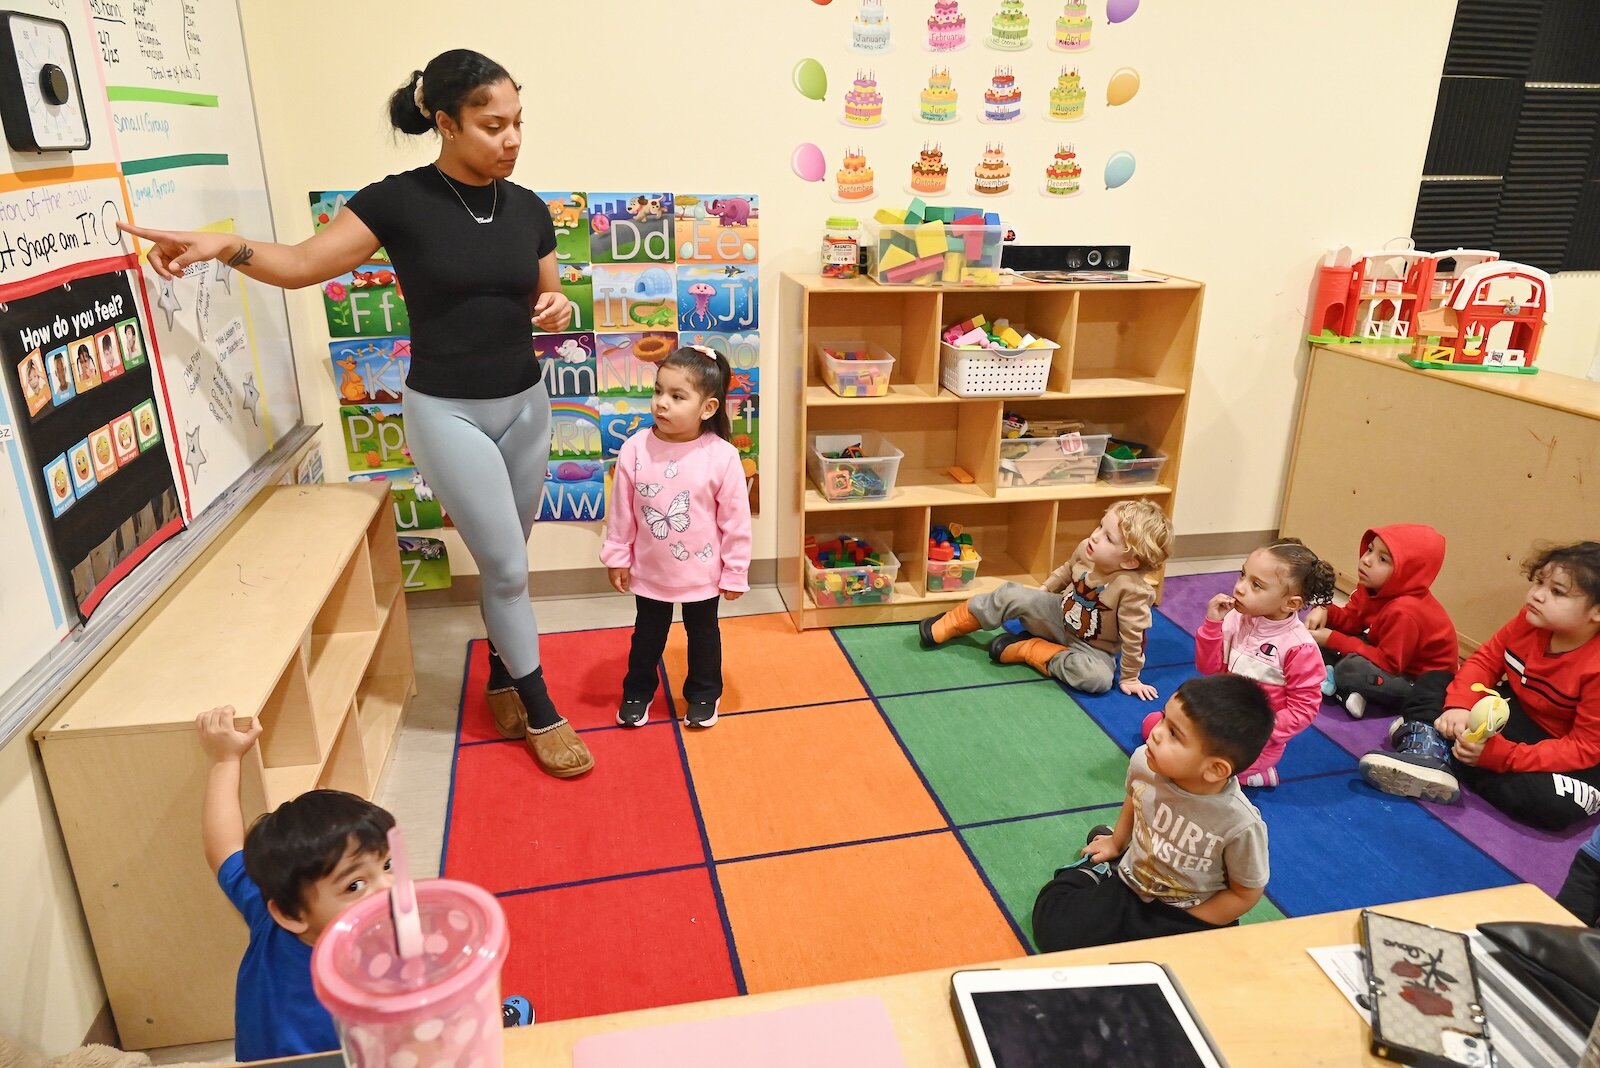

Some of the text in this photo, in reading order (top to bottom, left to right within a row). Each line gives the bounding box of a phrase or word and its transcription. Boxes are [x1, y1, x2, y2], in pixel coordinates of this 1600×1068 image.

[856, 33, 887, 45] January
[931, 33, 963, 41] February
[998, 31, 1021, 40] March
[1065, 33, 1082, 42] April
[929, 105, 947, 114] June
[994, 105, 1010, 114] July
[1055, 104, 1079, 112] August
[114, 112, 169, 139] Small Group
[838, 185, 874, 193] September
[914, 177, 941, 187] October
[975, 178, 1009, 187] November
[1047, 179, 1080, 187] December
[26, 192, 40, 219] of
[42, 187, 61, 214] the
[59, 232, 80, 251] am
[611, 219, 669, 260] Dd
[693, 219, 742, 260] Ee
[718, 276, 754, 326] Jj
[349, 290, 395, 334] Ff
[20, 294, 123, 352] How do you feel?
[602, 355, 658, 393] Nn
[348, 415, 405, 461] Pp
[557, 420, 597, 456] Rr
[1152, 803, 1224, 858] DIRT
[1138, 826, 1213, 872] NSTER
[1382, 938, 1426, 959] Love
